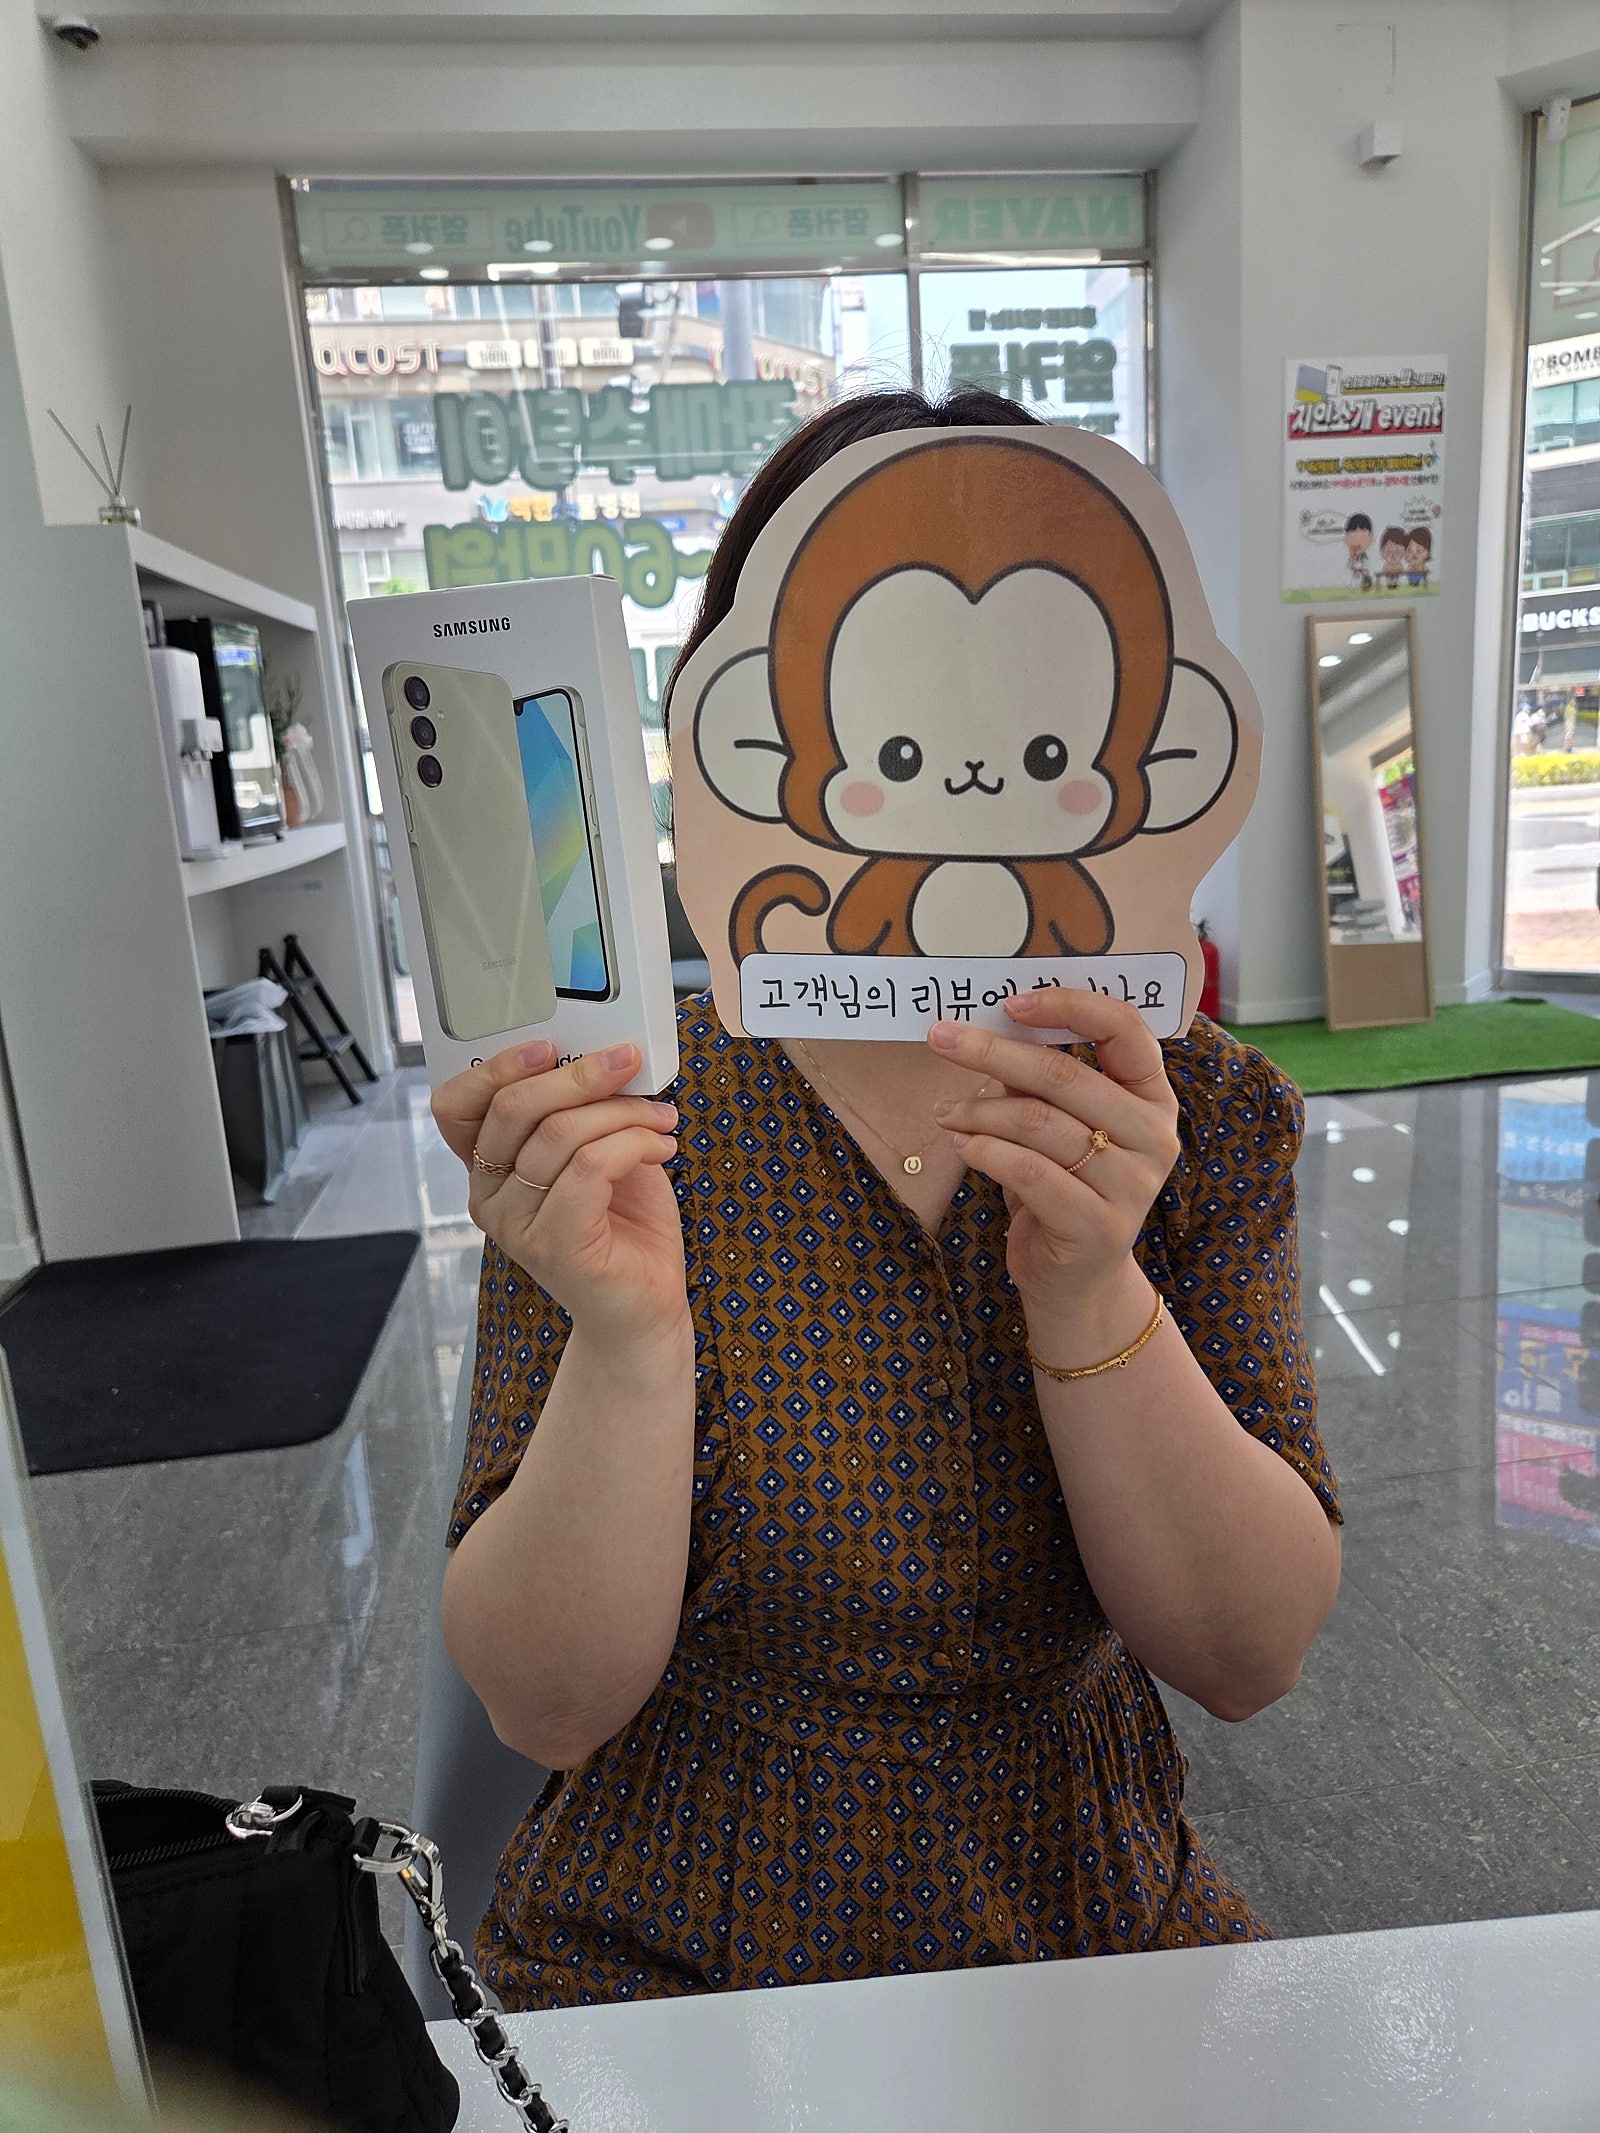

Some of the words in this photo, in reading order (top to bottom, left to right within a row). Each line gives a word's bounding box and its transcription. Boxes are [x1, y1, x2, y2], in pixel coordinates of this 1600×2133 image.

[1377, 396, 1445, 430] event
[433, 617, 511, 638] SAMSUNG
[1521, 606, 1600, 633] BUCKS
[481, 957, 518, 971] SAMSUNG
[758, 973, 897, 1018] 고객님의
[911, 975, 1018, 1022] 리뷰에
